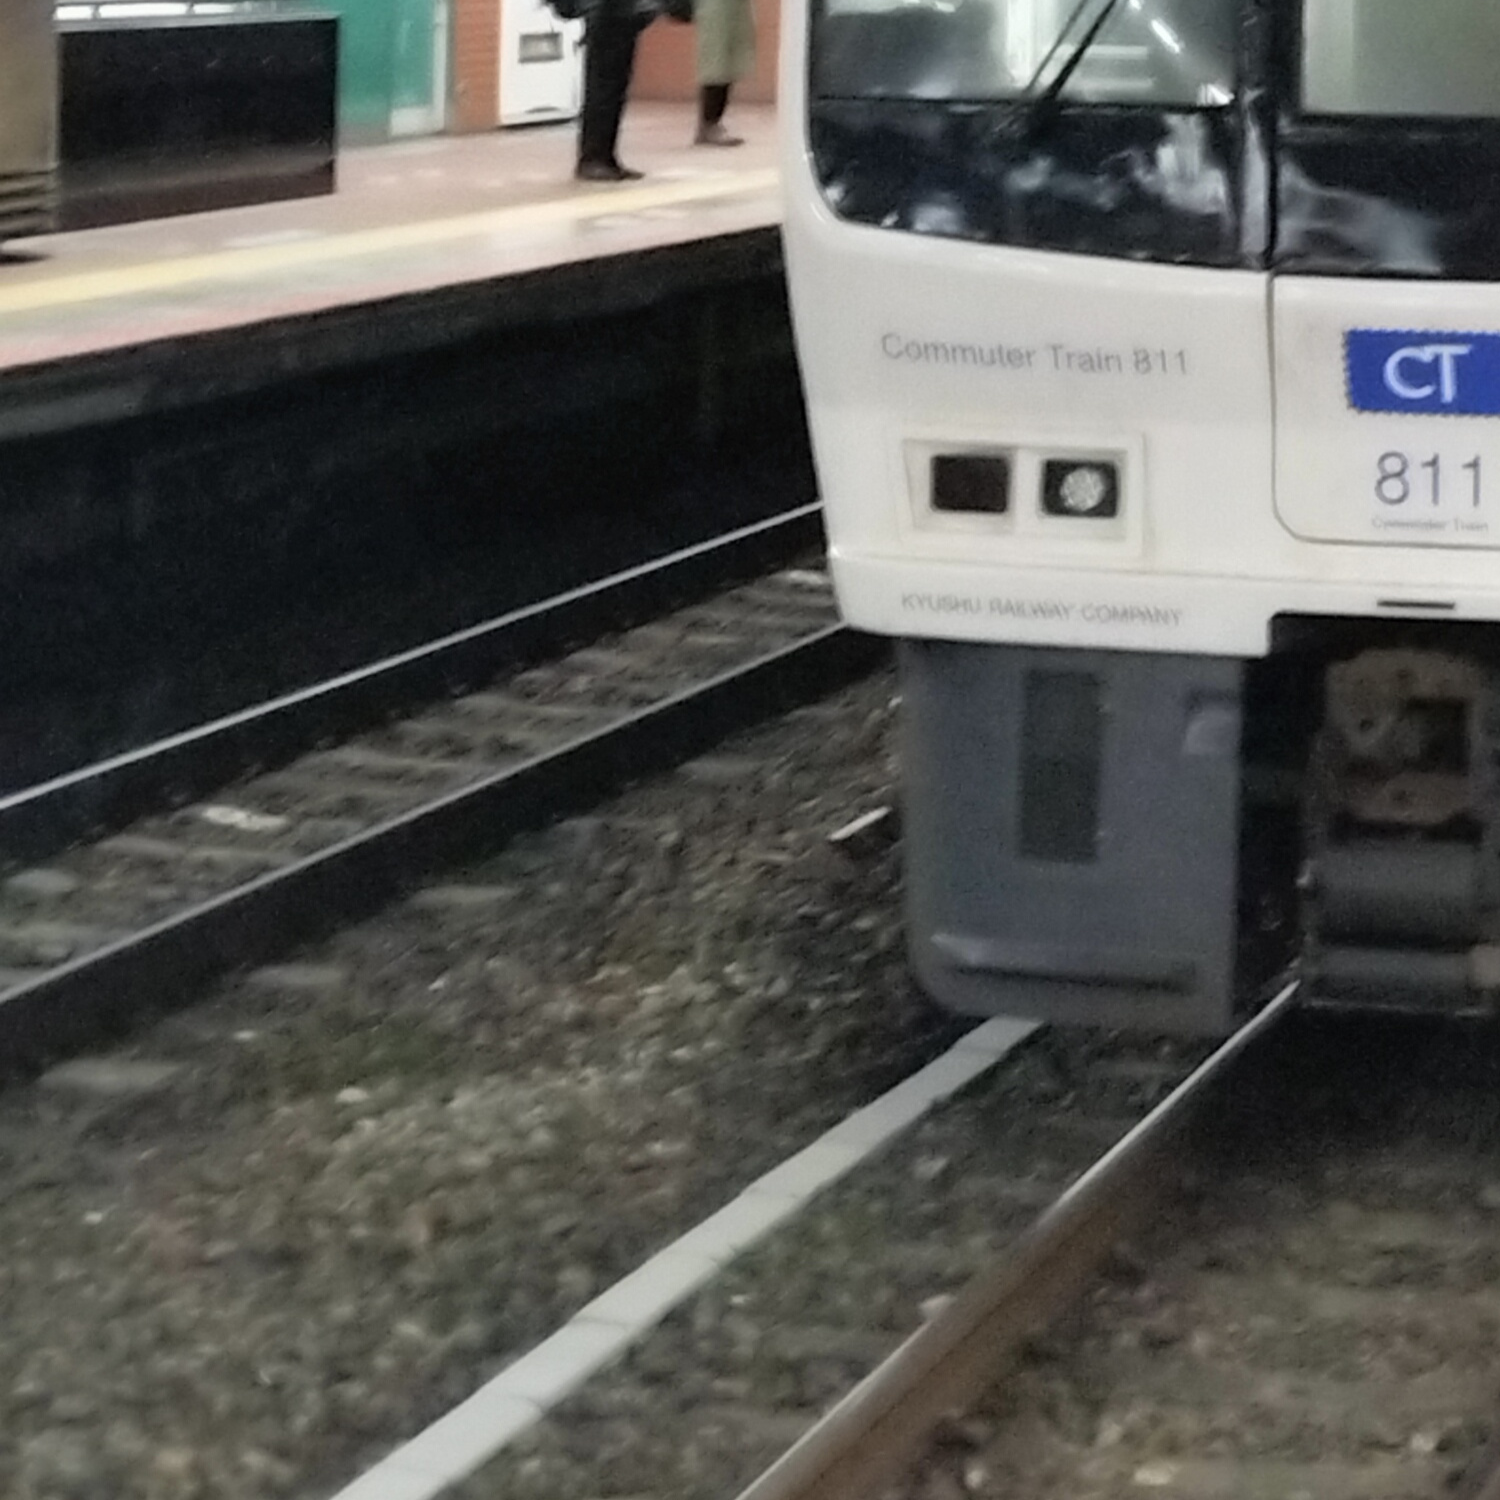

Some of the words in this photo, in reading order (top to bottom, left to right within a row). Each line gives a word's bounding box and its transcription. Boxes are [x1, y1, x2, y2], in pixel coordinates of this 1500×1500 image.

[881, 332, 1037, 369] Commuter
[1049, 342, 1123, 374] Train
[1133, 348, 1188, 375] 811
[1383, 344, 1474, 403] CT
[1374, 451, 1481, 508] 811
[900, 593, 982, 614] KYUSHU
[988, 597, 1074, 621] RAILWAY
[1079, 604, 1183, 626] COMPANY
